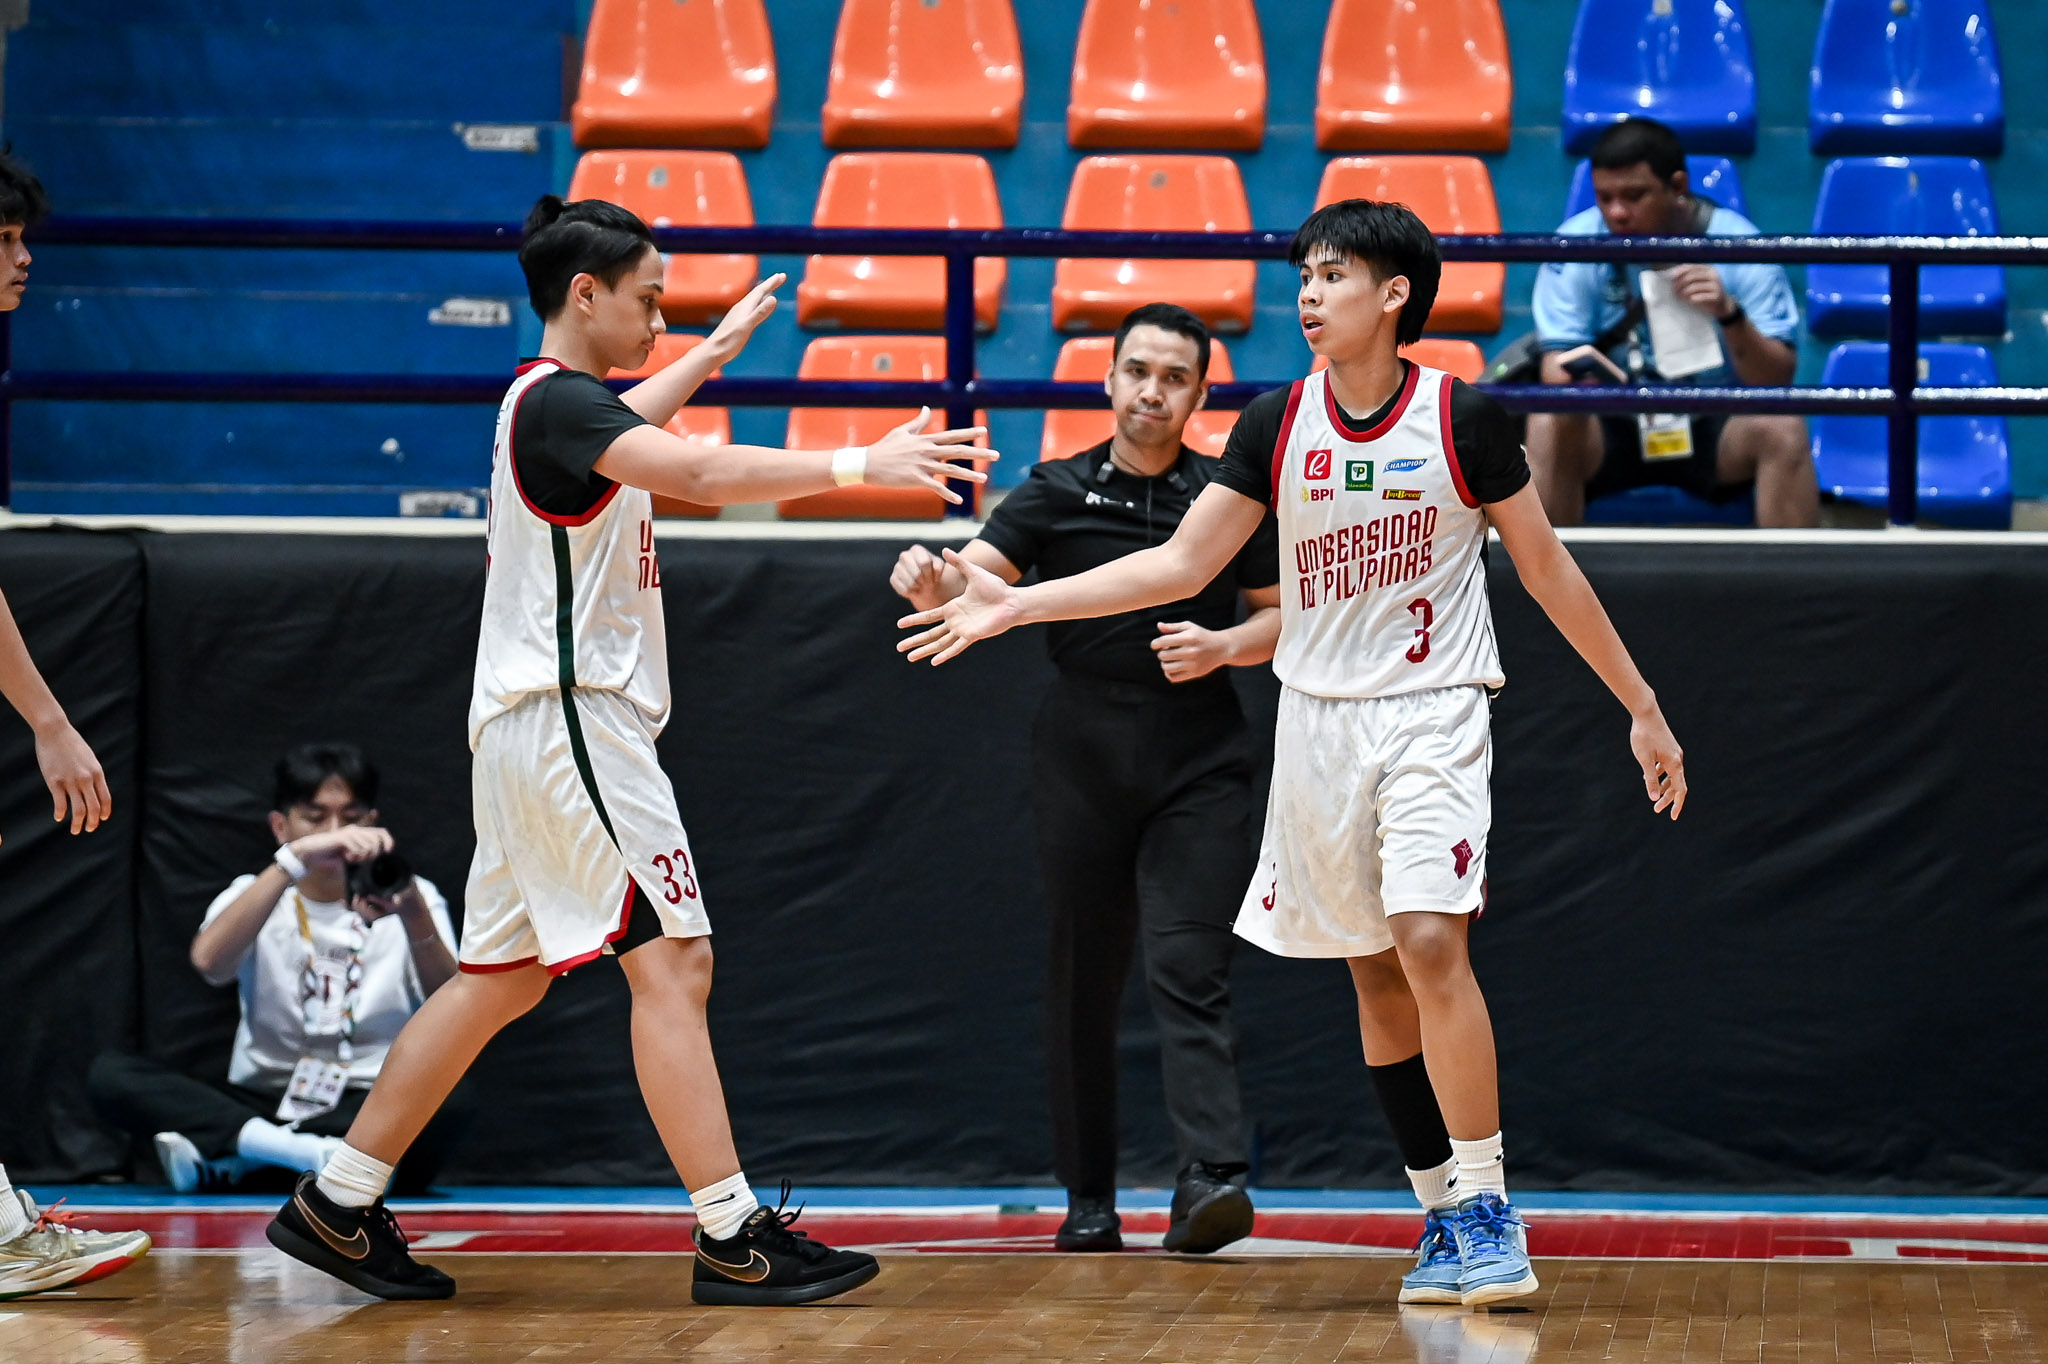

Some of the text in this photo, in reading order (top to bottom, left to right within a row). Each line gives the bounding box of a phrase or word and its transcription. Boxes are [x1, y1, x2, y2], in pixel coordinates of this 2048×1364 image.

[1310, 488, 1334, 501] BPI
[1385, 459, 1425, 471] CHAMPION
[1295, 505, 1438, 574] UNIBERSIDAD
[1323, 540, 1433, 604] PILIPINAS
[1405, 597, 1434, 664] 3
[651, 848, 697, 905] 33
